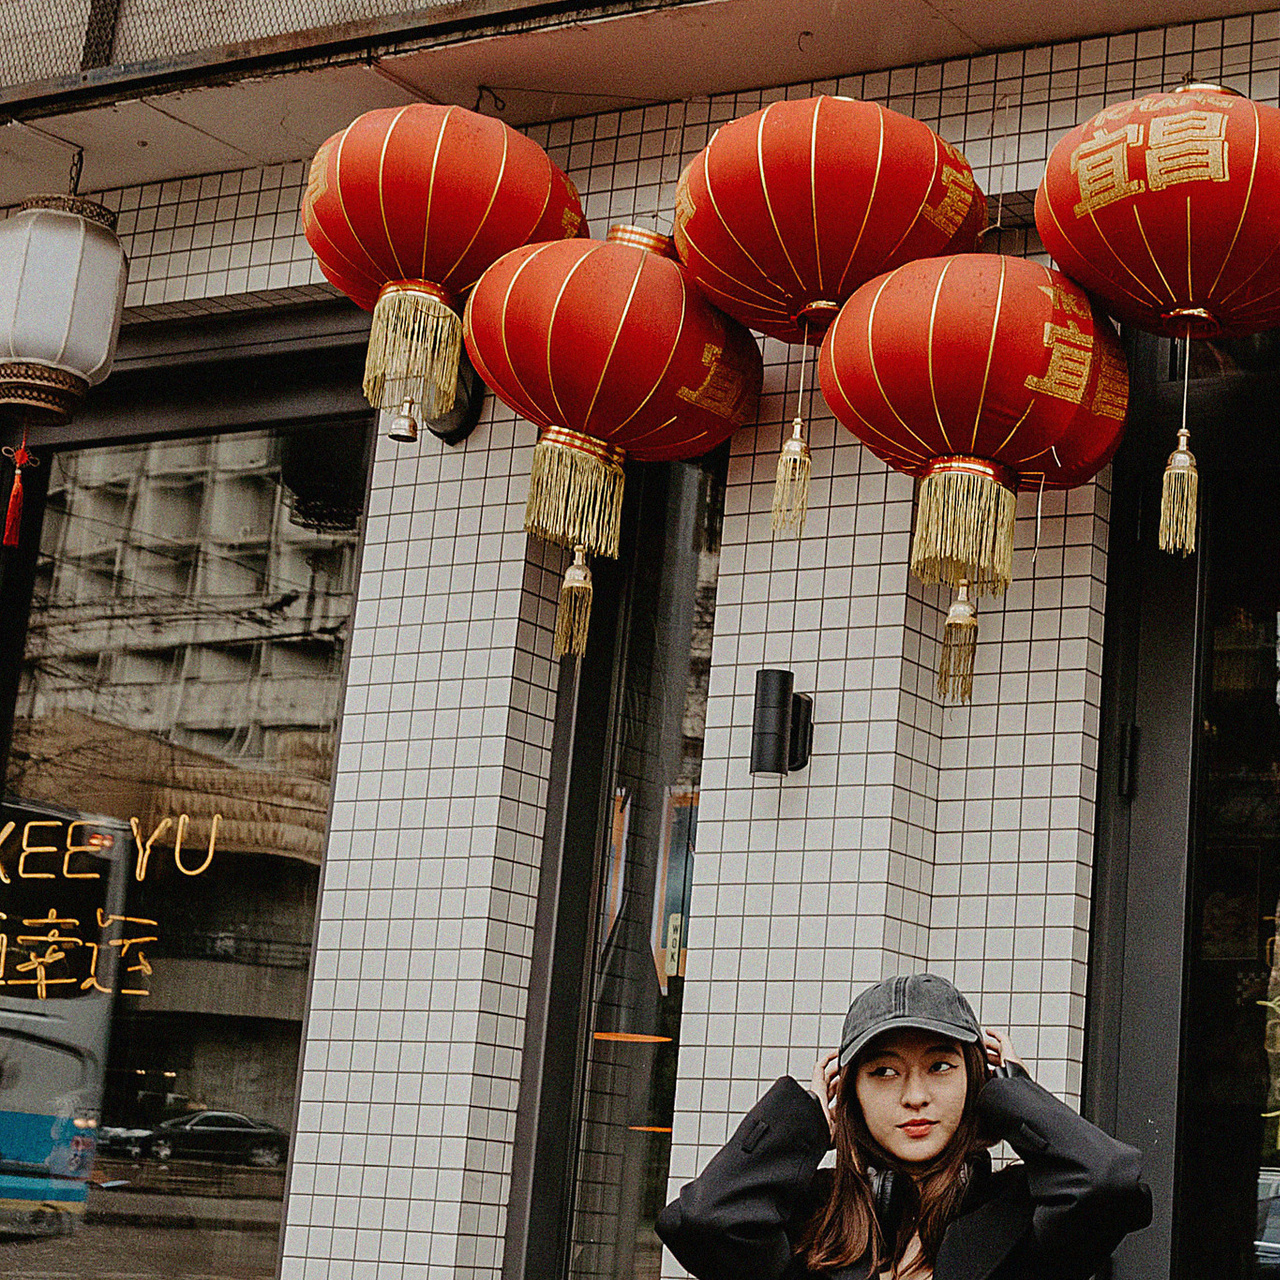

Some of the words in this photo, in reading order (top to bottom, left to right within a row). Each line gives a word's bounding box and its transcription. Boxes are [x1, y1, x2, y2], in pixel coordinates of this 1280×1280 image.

[1073, 109, 1230, 219] 宜昌
[130, 814, 223, 881] YU
[0, 908, 158, 1000] 幸运
